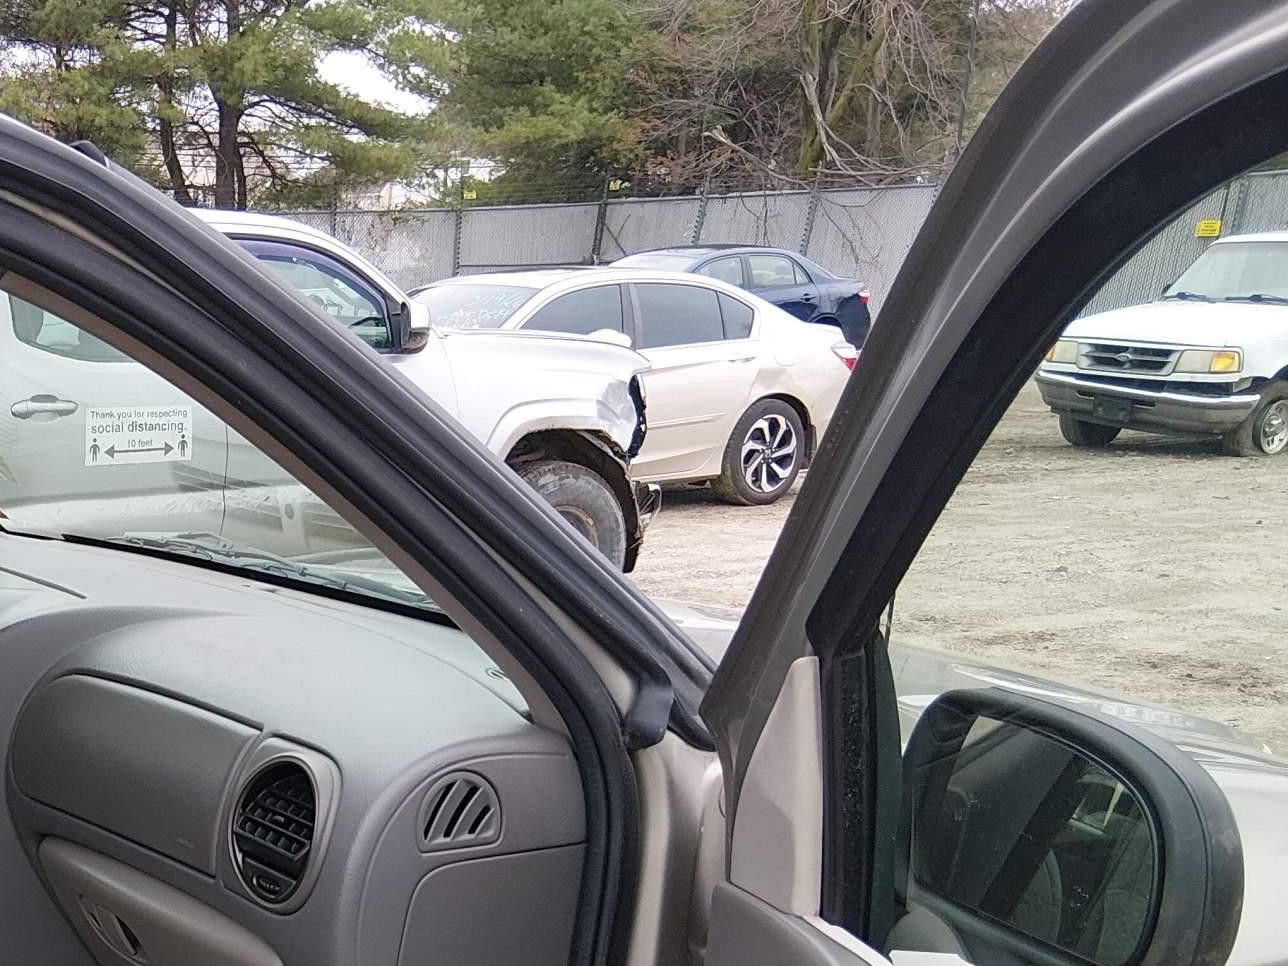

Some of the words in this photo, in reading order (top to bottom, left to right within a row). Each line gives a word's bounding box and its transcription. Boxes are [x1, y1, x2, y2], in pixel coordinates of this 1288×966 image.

[90, 410, 115, 420] Thank
[117, 411, 132, 421] you
[134, 410, 145, 418] for
[146, 409, 188, 419] respecting
[91, 422, 124, 434] social
[127, 420, 188, 434] distancing.
[127, 439, 137, 448] 10
[138, 438, 153, 447] feet
